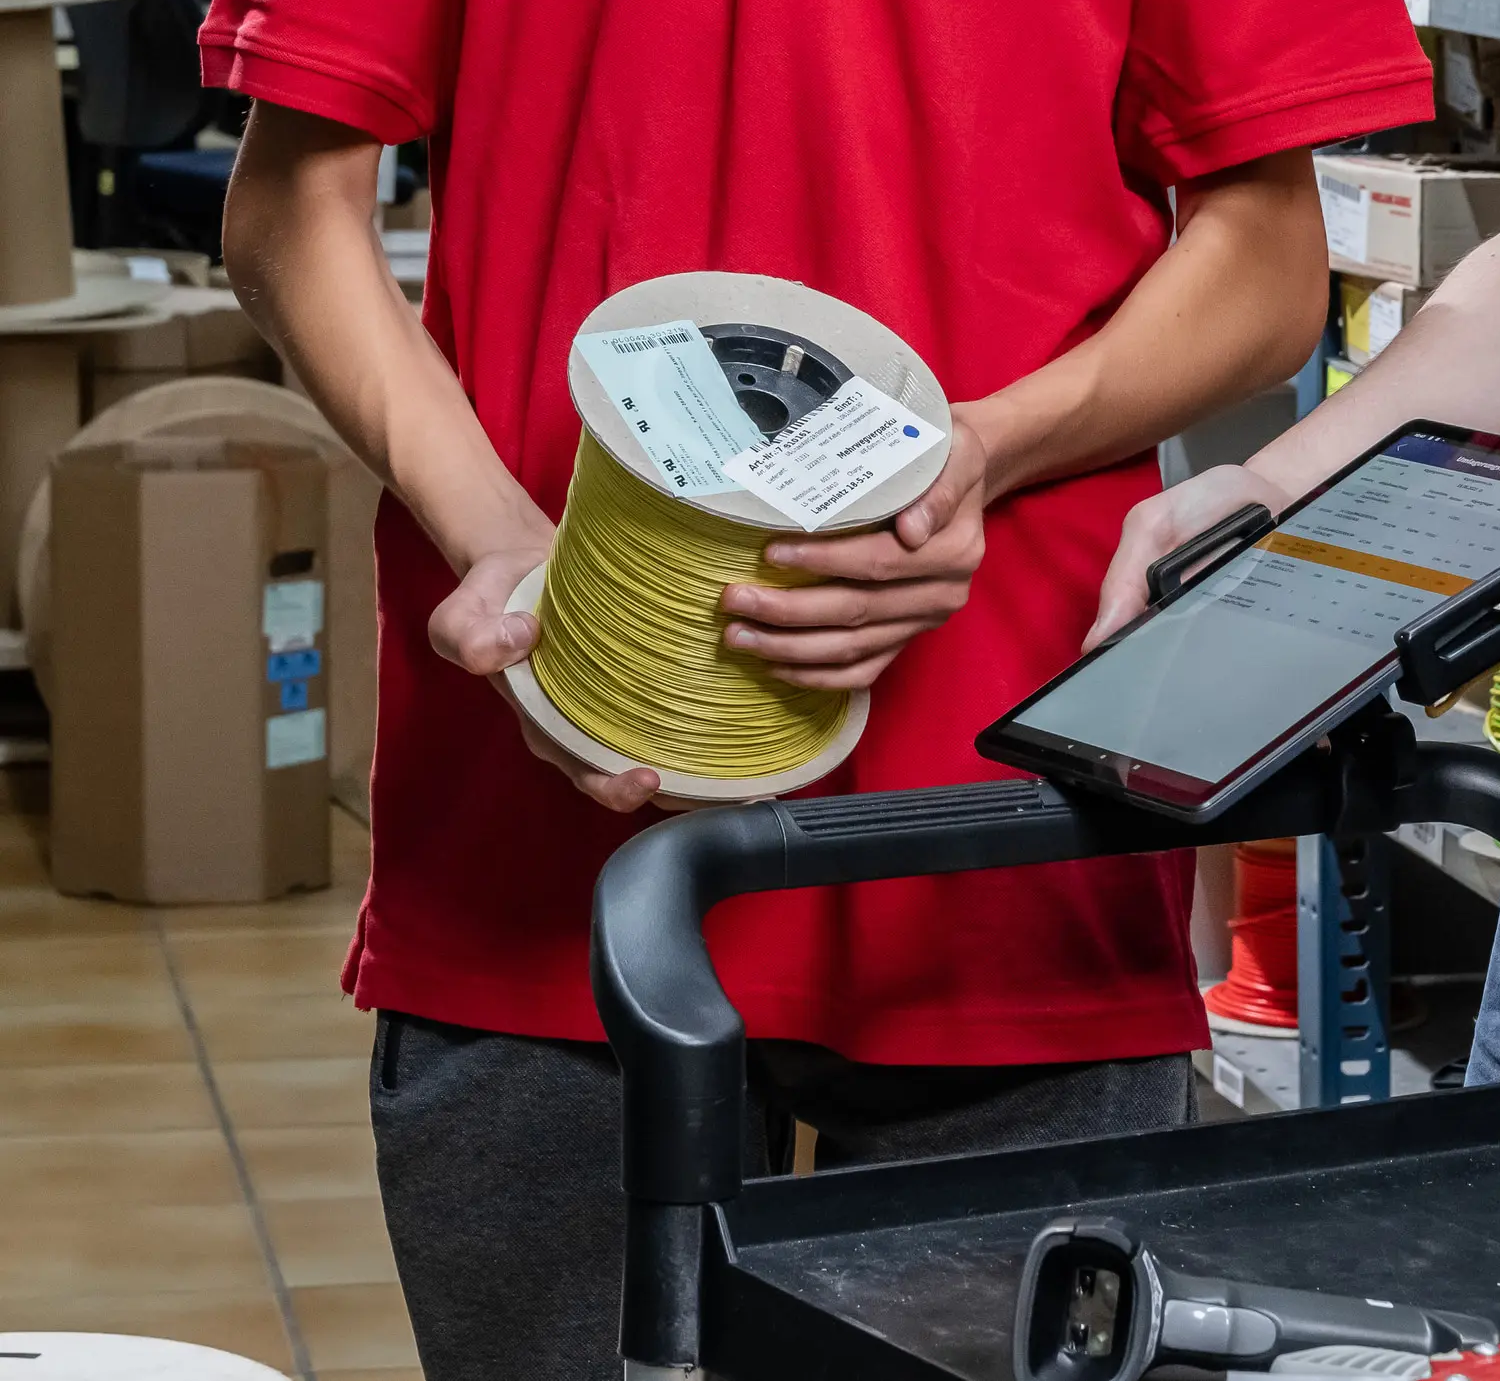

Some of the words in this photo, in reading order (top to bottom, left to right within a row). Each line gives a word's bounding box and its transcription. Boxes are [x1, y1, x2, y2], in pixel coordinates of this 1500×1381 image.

[836, 417, 898, 460] Mehrwegverpacku
[811, 487, 849, 515] Lagerplatz
[846, 470, 874, 491] 18-5-19
